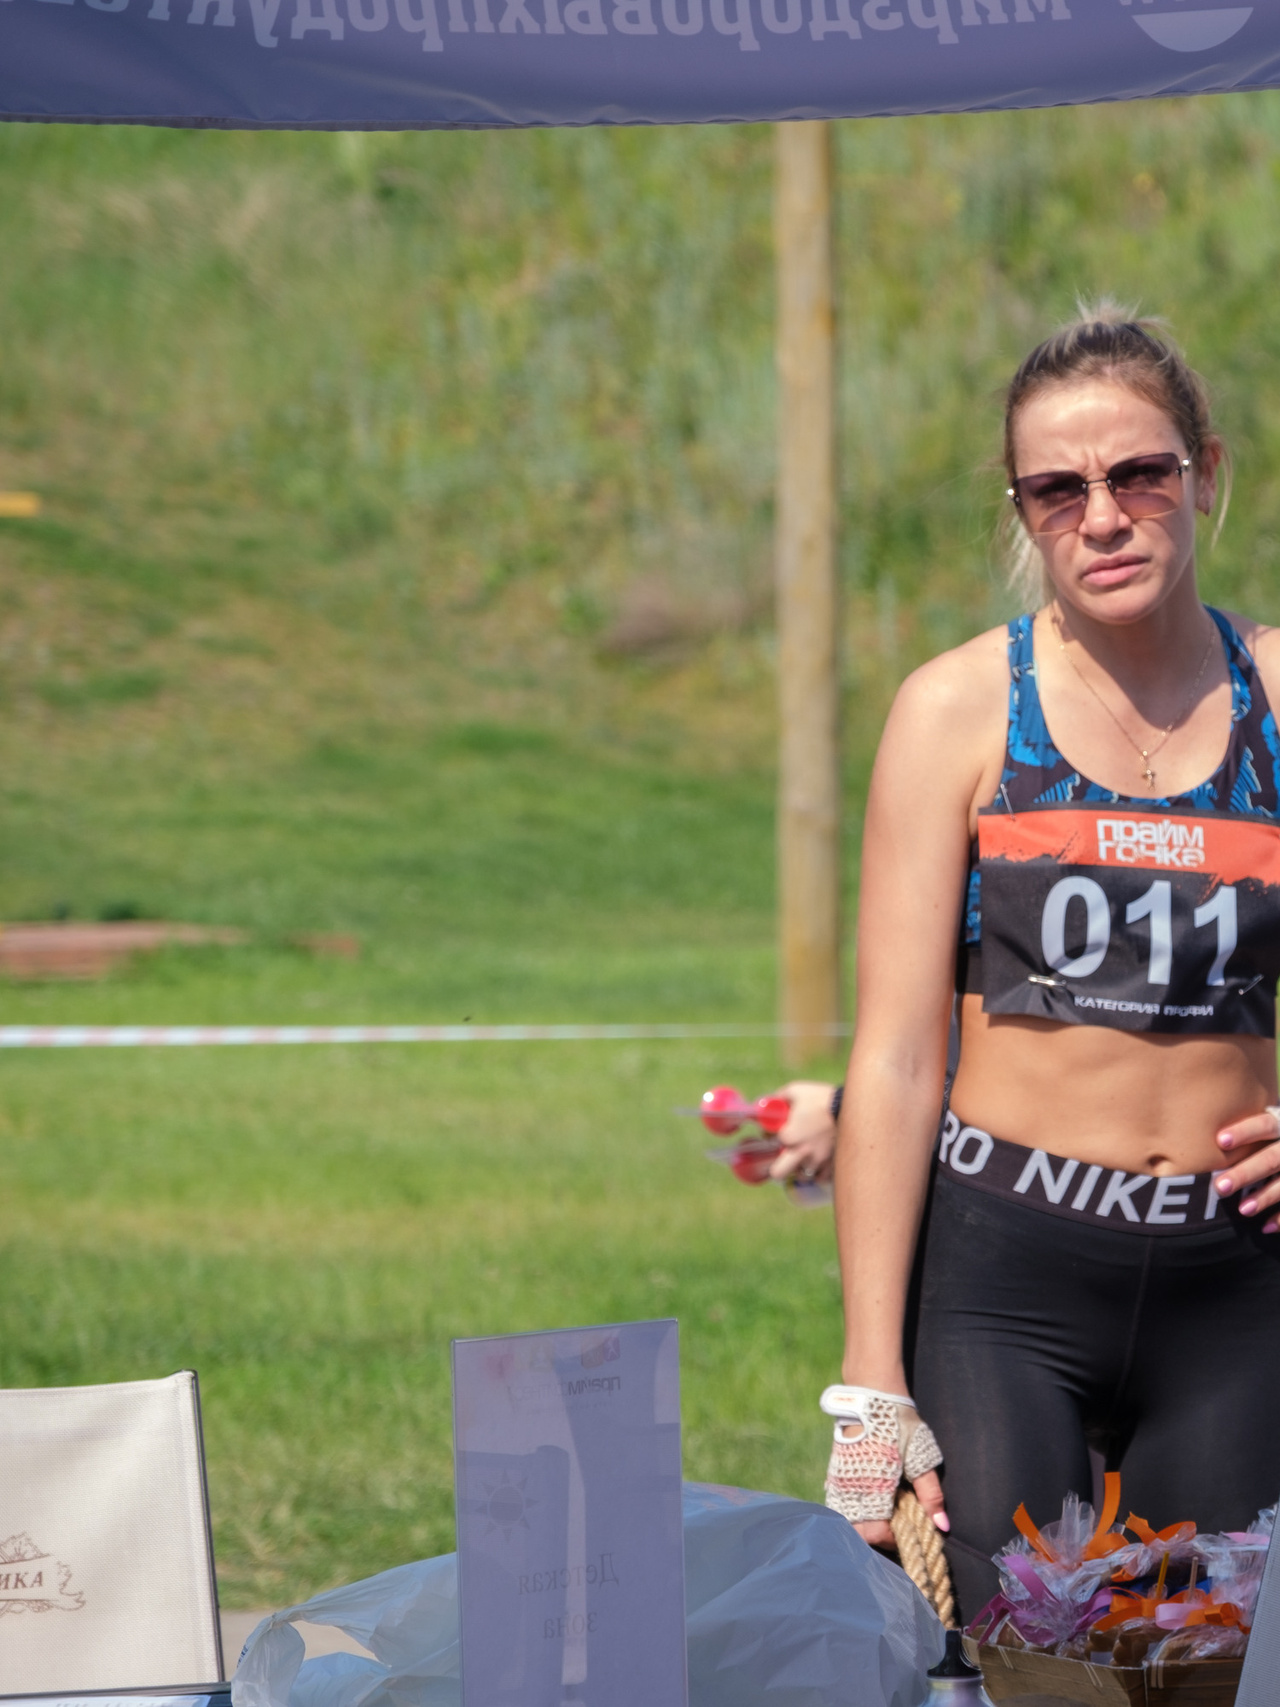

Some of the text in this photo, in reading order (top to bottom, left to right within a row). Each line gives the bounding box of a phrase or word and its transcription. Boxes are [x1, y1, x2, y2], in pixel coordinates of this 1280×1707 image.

[1041, 875, 1238, 987] 011
[1074, 996, 1160, 1015] КАТЕГОРИЯ
[1013, 1149, 1196, 1225] NIKE
